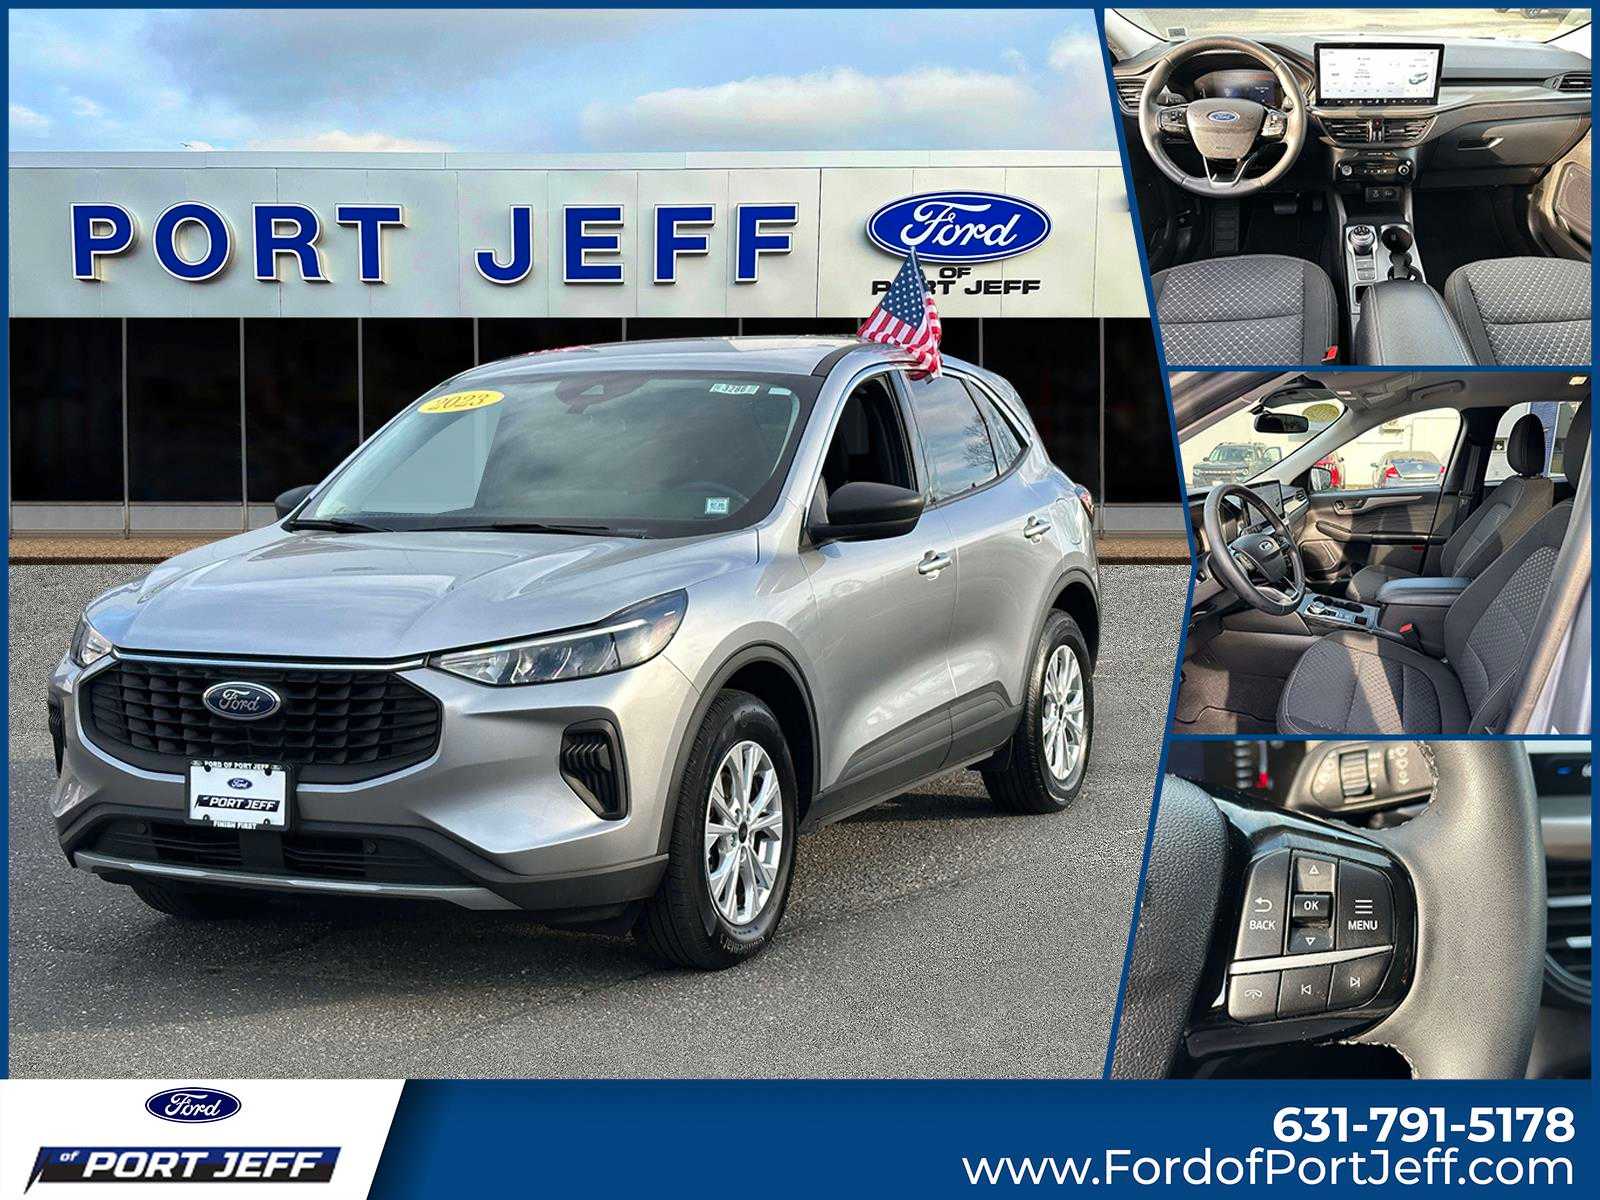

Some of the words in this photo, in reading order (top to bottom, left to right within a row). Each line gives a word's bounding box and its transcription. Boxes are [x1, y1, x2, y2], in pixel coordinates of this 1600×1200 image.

[900, 201, 1022, 246] Ford
[70, 202, 403, 283] PORT
[474, 203, 799, 284] JEFF
[939, 267, 972, 279] OF
[965, 280, 1041, 295] JEFF
[219, 689, 260, 711] Ford
[204, 760, 222, 768] FORD
[224, 761, 233, 769] OF
[234, 762, 252, 770] PORT
[209, 797, 245, 808] PORT
[245, 799, 276, 811] JEFF
[1303, 901, 1319, 911] OK
[1249, 920, 1276, 931] BACK
[1348, 920, 1378, 931] MENU
